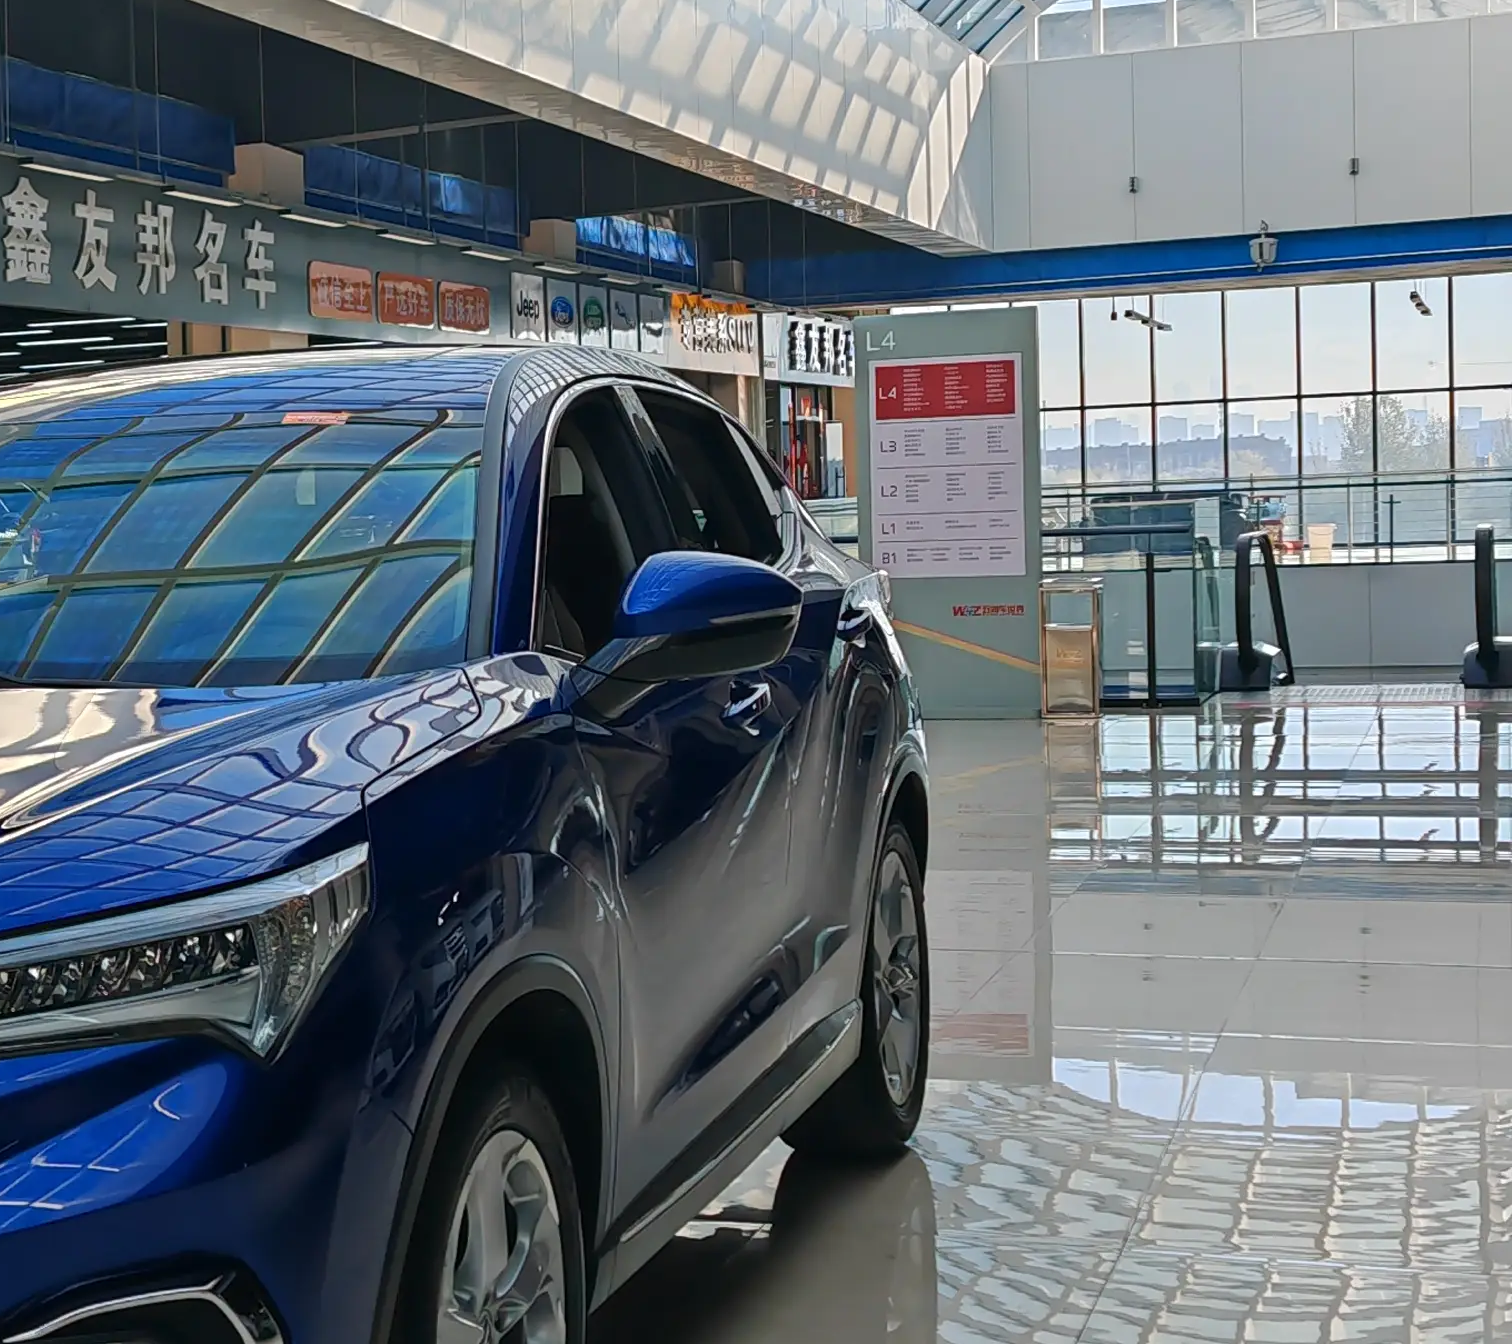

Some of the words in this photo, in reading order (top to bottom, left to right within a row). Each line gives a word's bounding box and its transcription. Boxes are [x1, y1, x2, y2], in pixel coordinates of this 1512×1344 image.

[1, 176, 279, 310] 鑫友邦名车
[516, 290, 540, 325] Jeep
[866, 330, 896, 352] L4
[879, 387, 897, 400] L4
[880, 440, 897, 453] L3
[880, 485, 898, 498] L2
[881, 523, 897, 535] L1
[882, 552, 897, 564] B1
